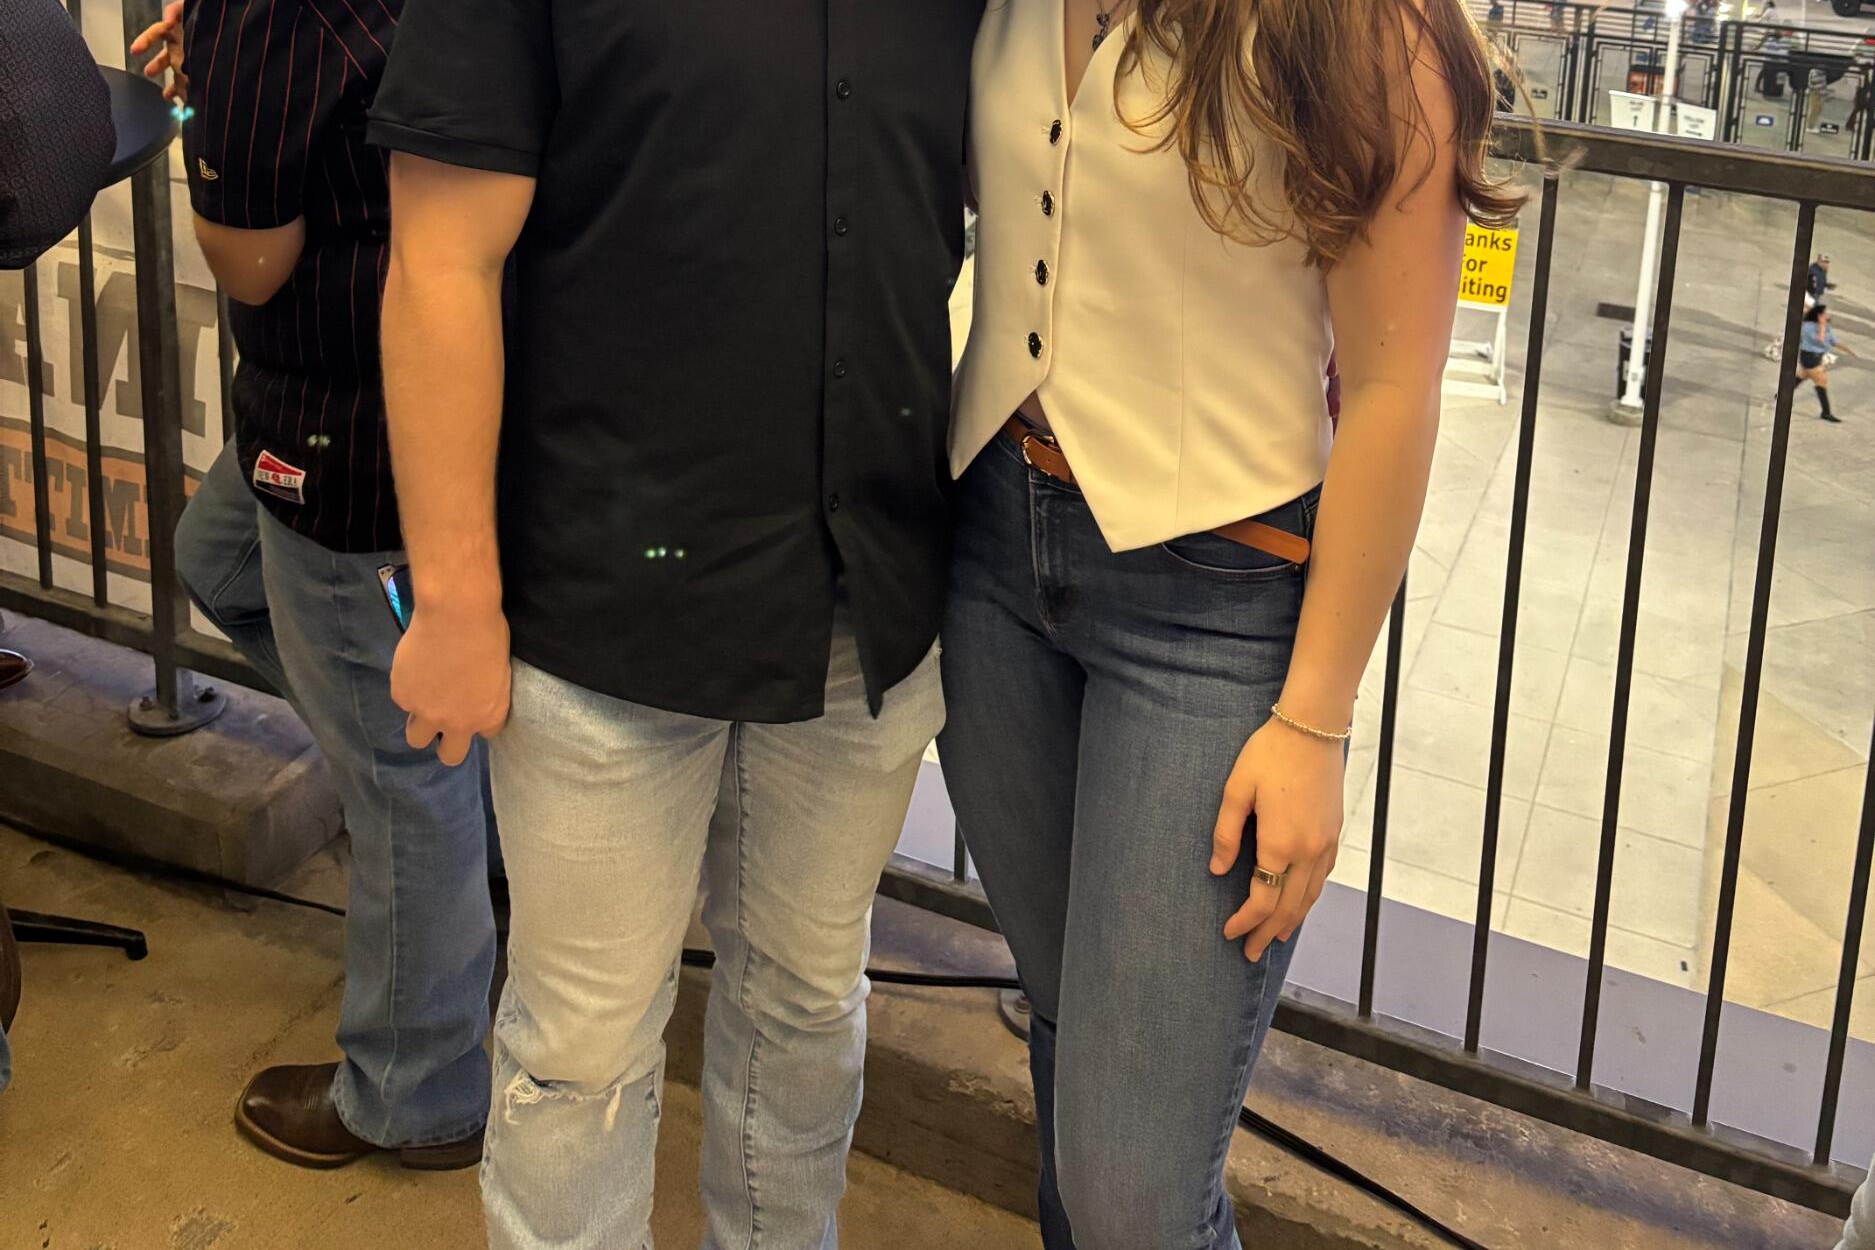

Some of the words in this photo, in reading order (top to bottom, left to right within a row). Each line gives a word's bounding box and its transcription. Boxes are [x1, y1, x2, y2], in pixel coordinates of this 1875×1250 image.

[1464, 232, 1512, 251] anks
[1462, 254, 1488, 272] or
[1461, 277, 1507, 303] iting
